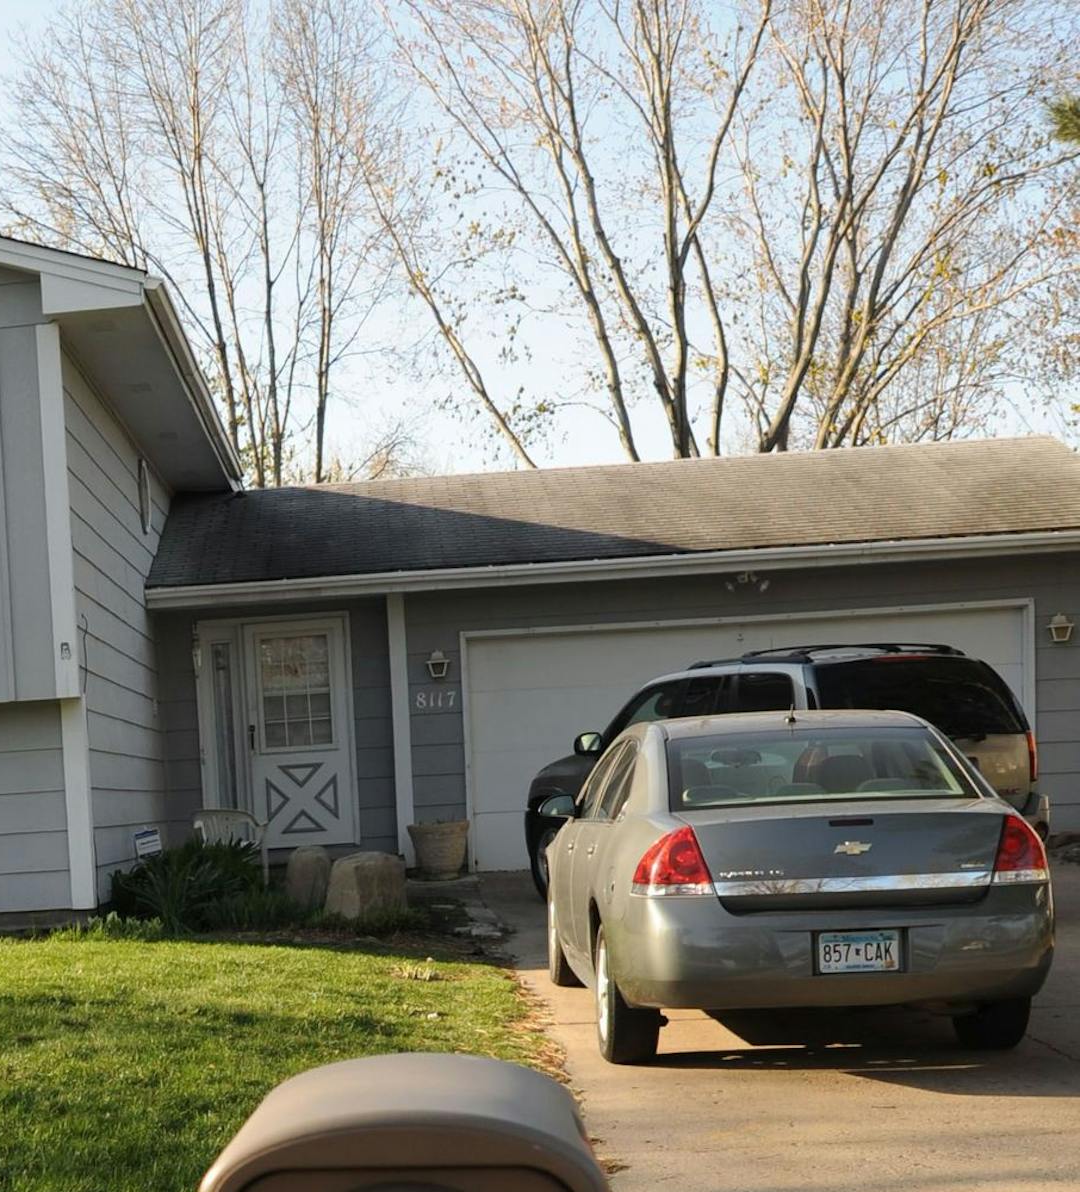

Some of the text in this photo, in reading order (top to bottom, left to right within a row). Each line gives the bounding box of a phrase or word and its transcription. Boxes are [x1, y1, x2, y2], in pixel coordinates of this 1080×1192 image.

[416, 690, 456, 709] 8117
[823, 941, 893, 963] 857 CAK
